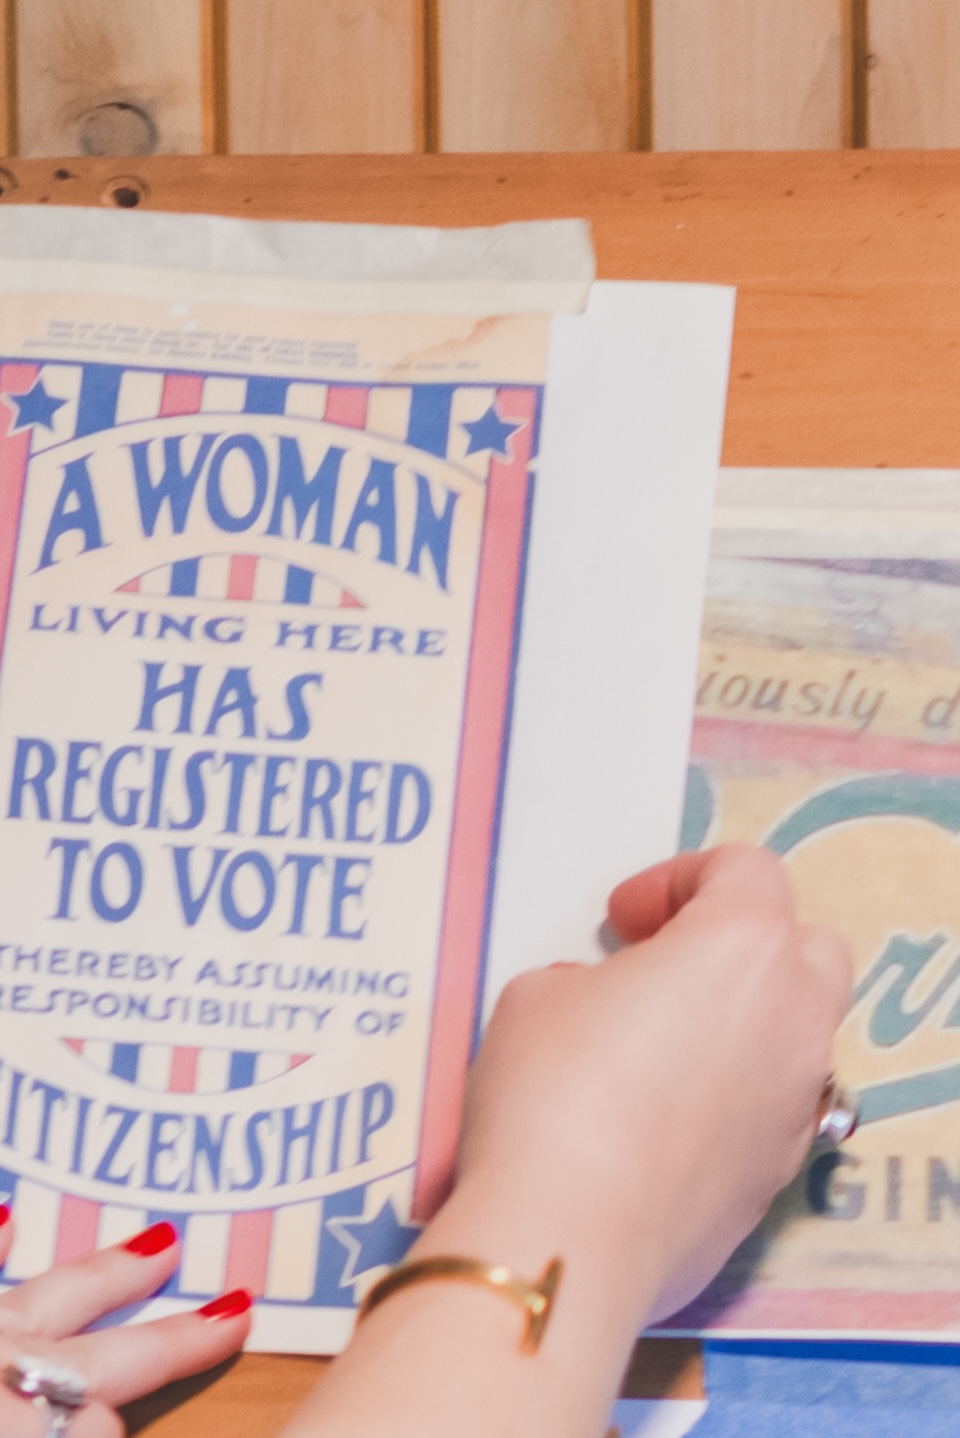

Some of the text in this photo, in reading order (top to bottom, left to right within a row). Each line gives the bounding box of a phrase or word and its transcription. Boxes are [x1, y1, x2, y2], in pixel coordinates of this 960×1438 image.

[30, 432, 462, 597] A WOMAN
[29, 603, 449, 658] LIVING HERE
[134, 661, 324, 742] HAS
[5, 737, 434, 846] REGISTERED
[45, 837, 374, 941] TO VOTE
[194, 960, 413, 1001] ASSUMING
[354, 1010, 407, 1038] OF
